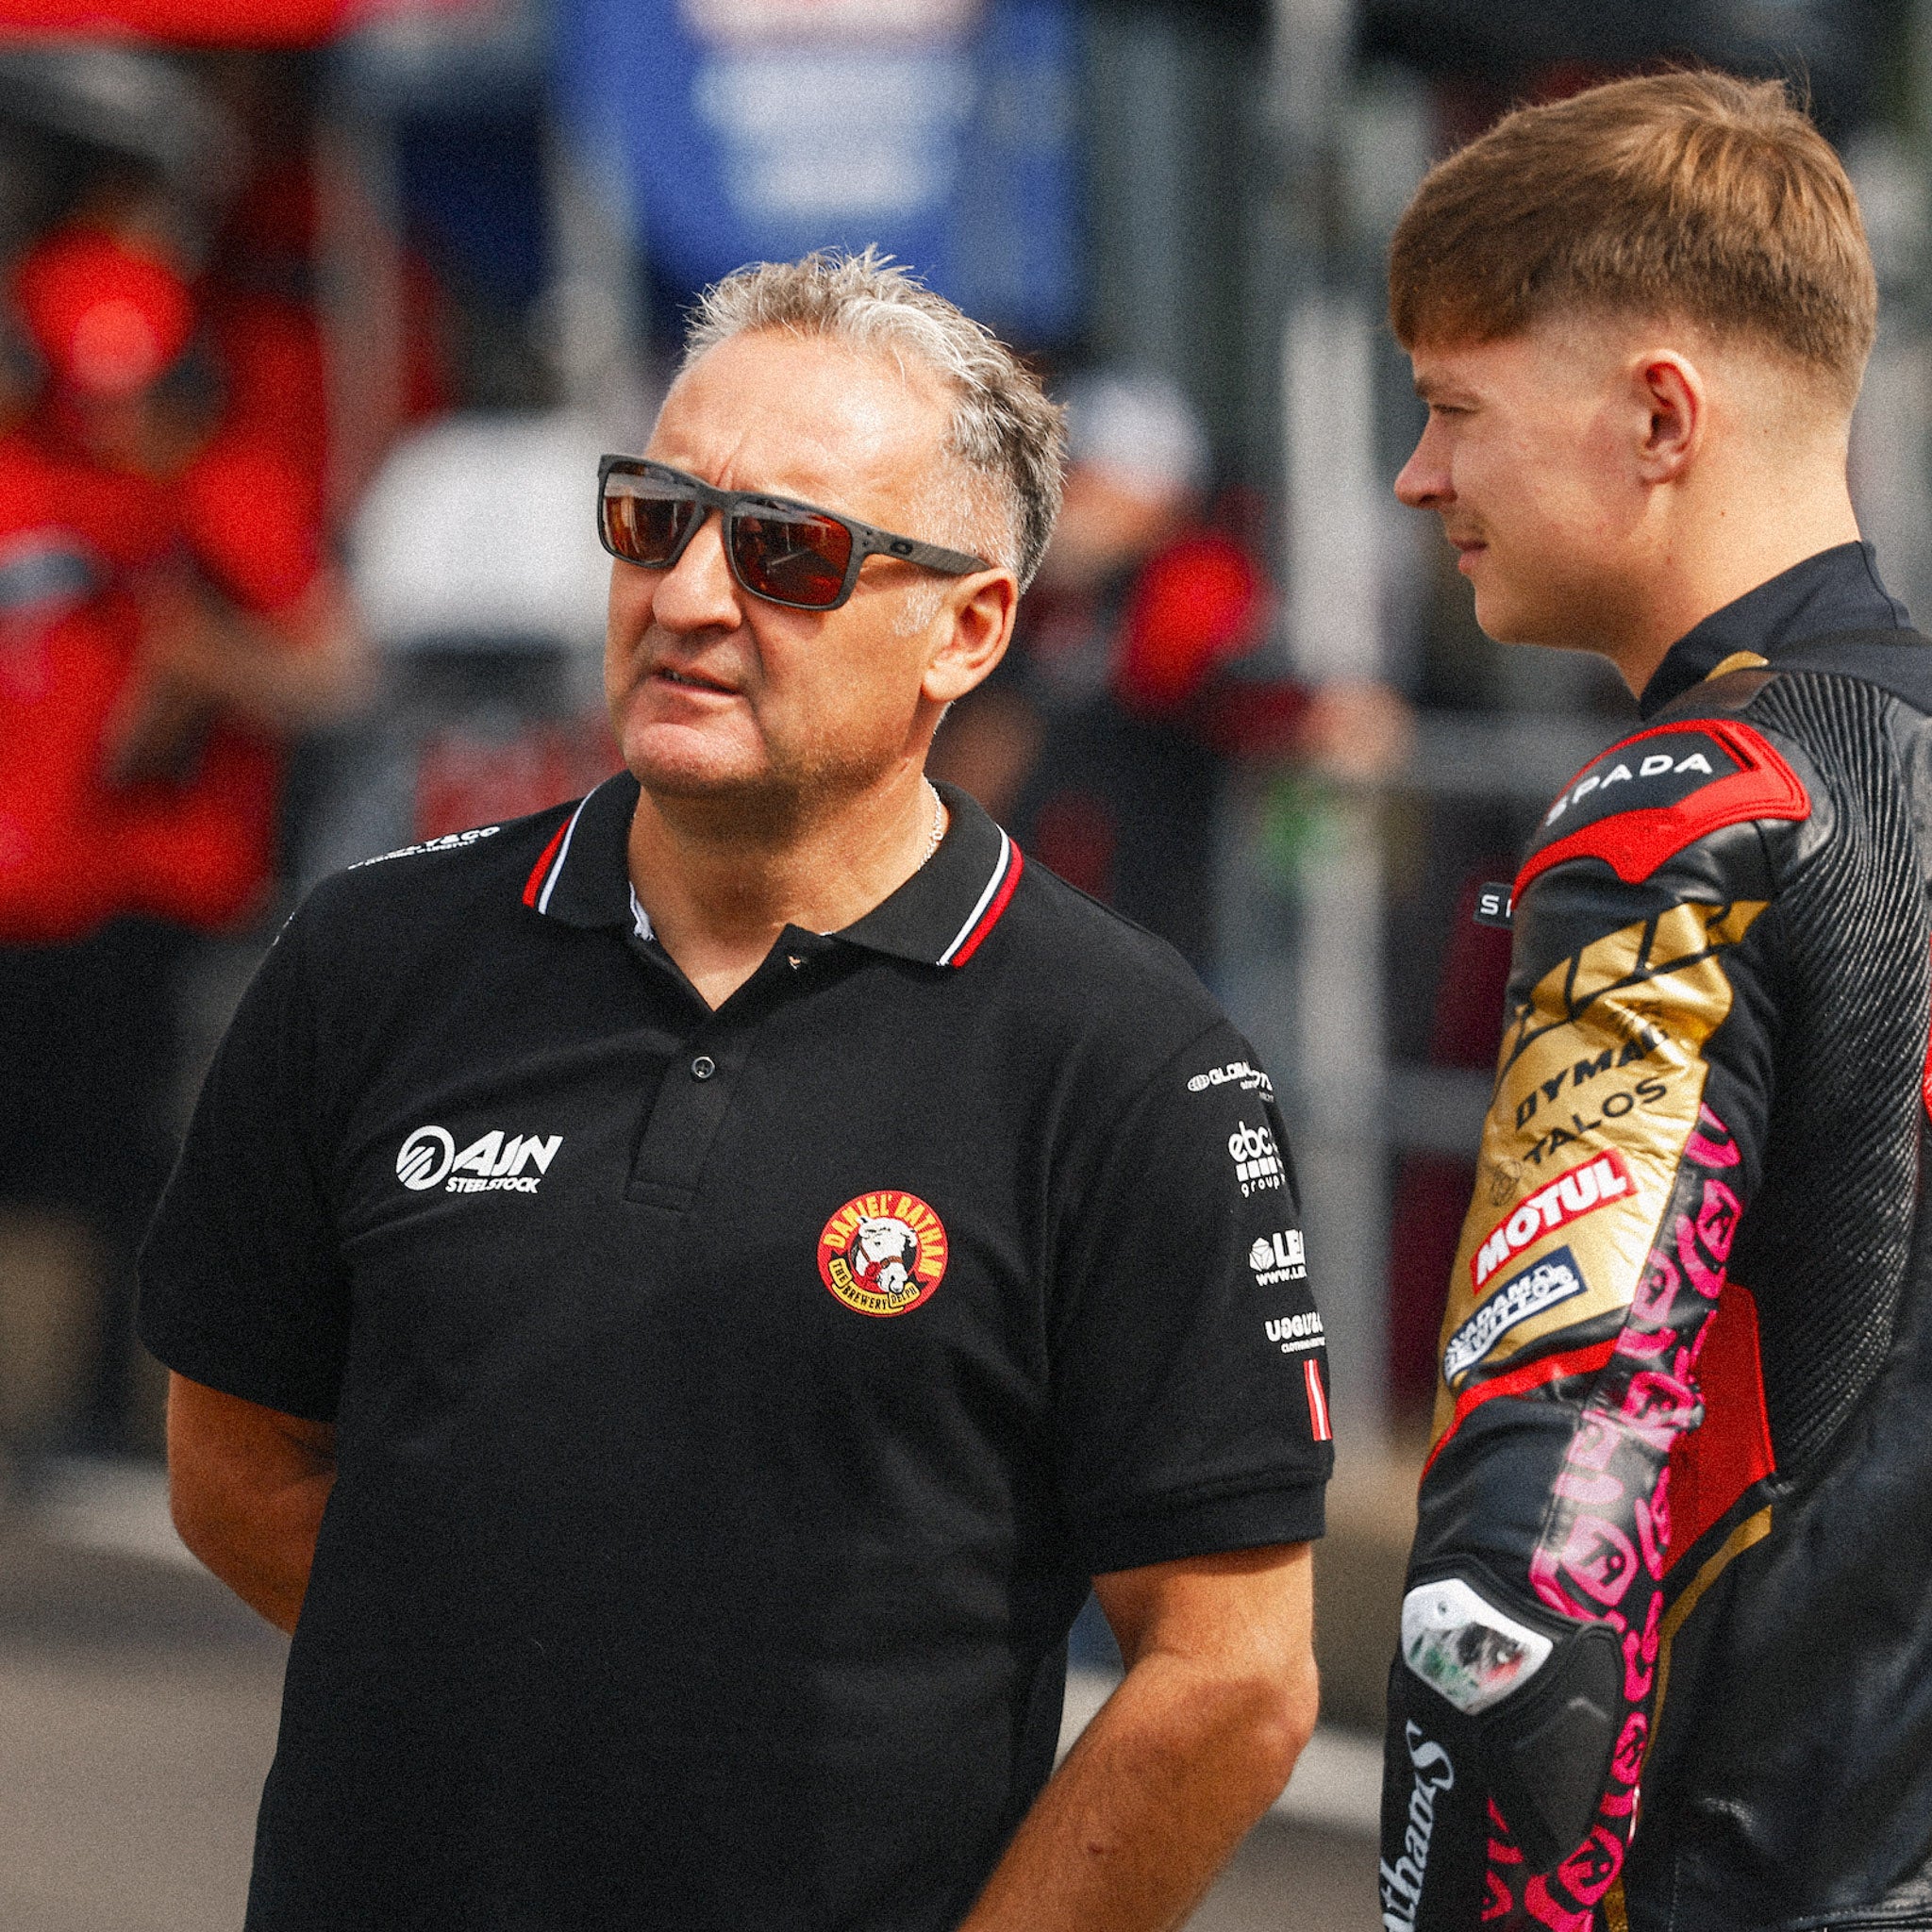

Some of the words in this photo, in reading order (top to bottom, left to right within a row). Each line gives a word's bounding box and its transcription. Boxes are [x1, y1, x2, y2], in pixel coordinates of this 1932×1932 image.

[1228, 1121, 1273, 1162] ebc
[1524, 1077, 1667, 1164] TALOS
[451, 1130, 564, 1176] AJN
[445, 1176, 541, 1193] STEELSTOCK
[1241, 1175, 1280, 1198] group
[894, 1195, 945, 1278] BATHAM
[1476, 1158, 1627, 1285] MOTUL
[833, 1261, 848, 1283] THE
[842, 1285, 887, 1310] BREWERY
